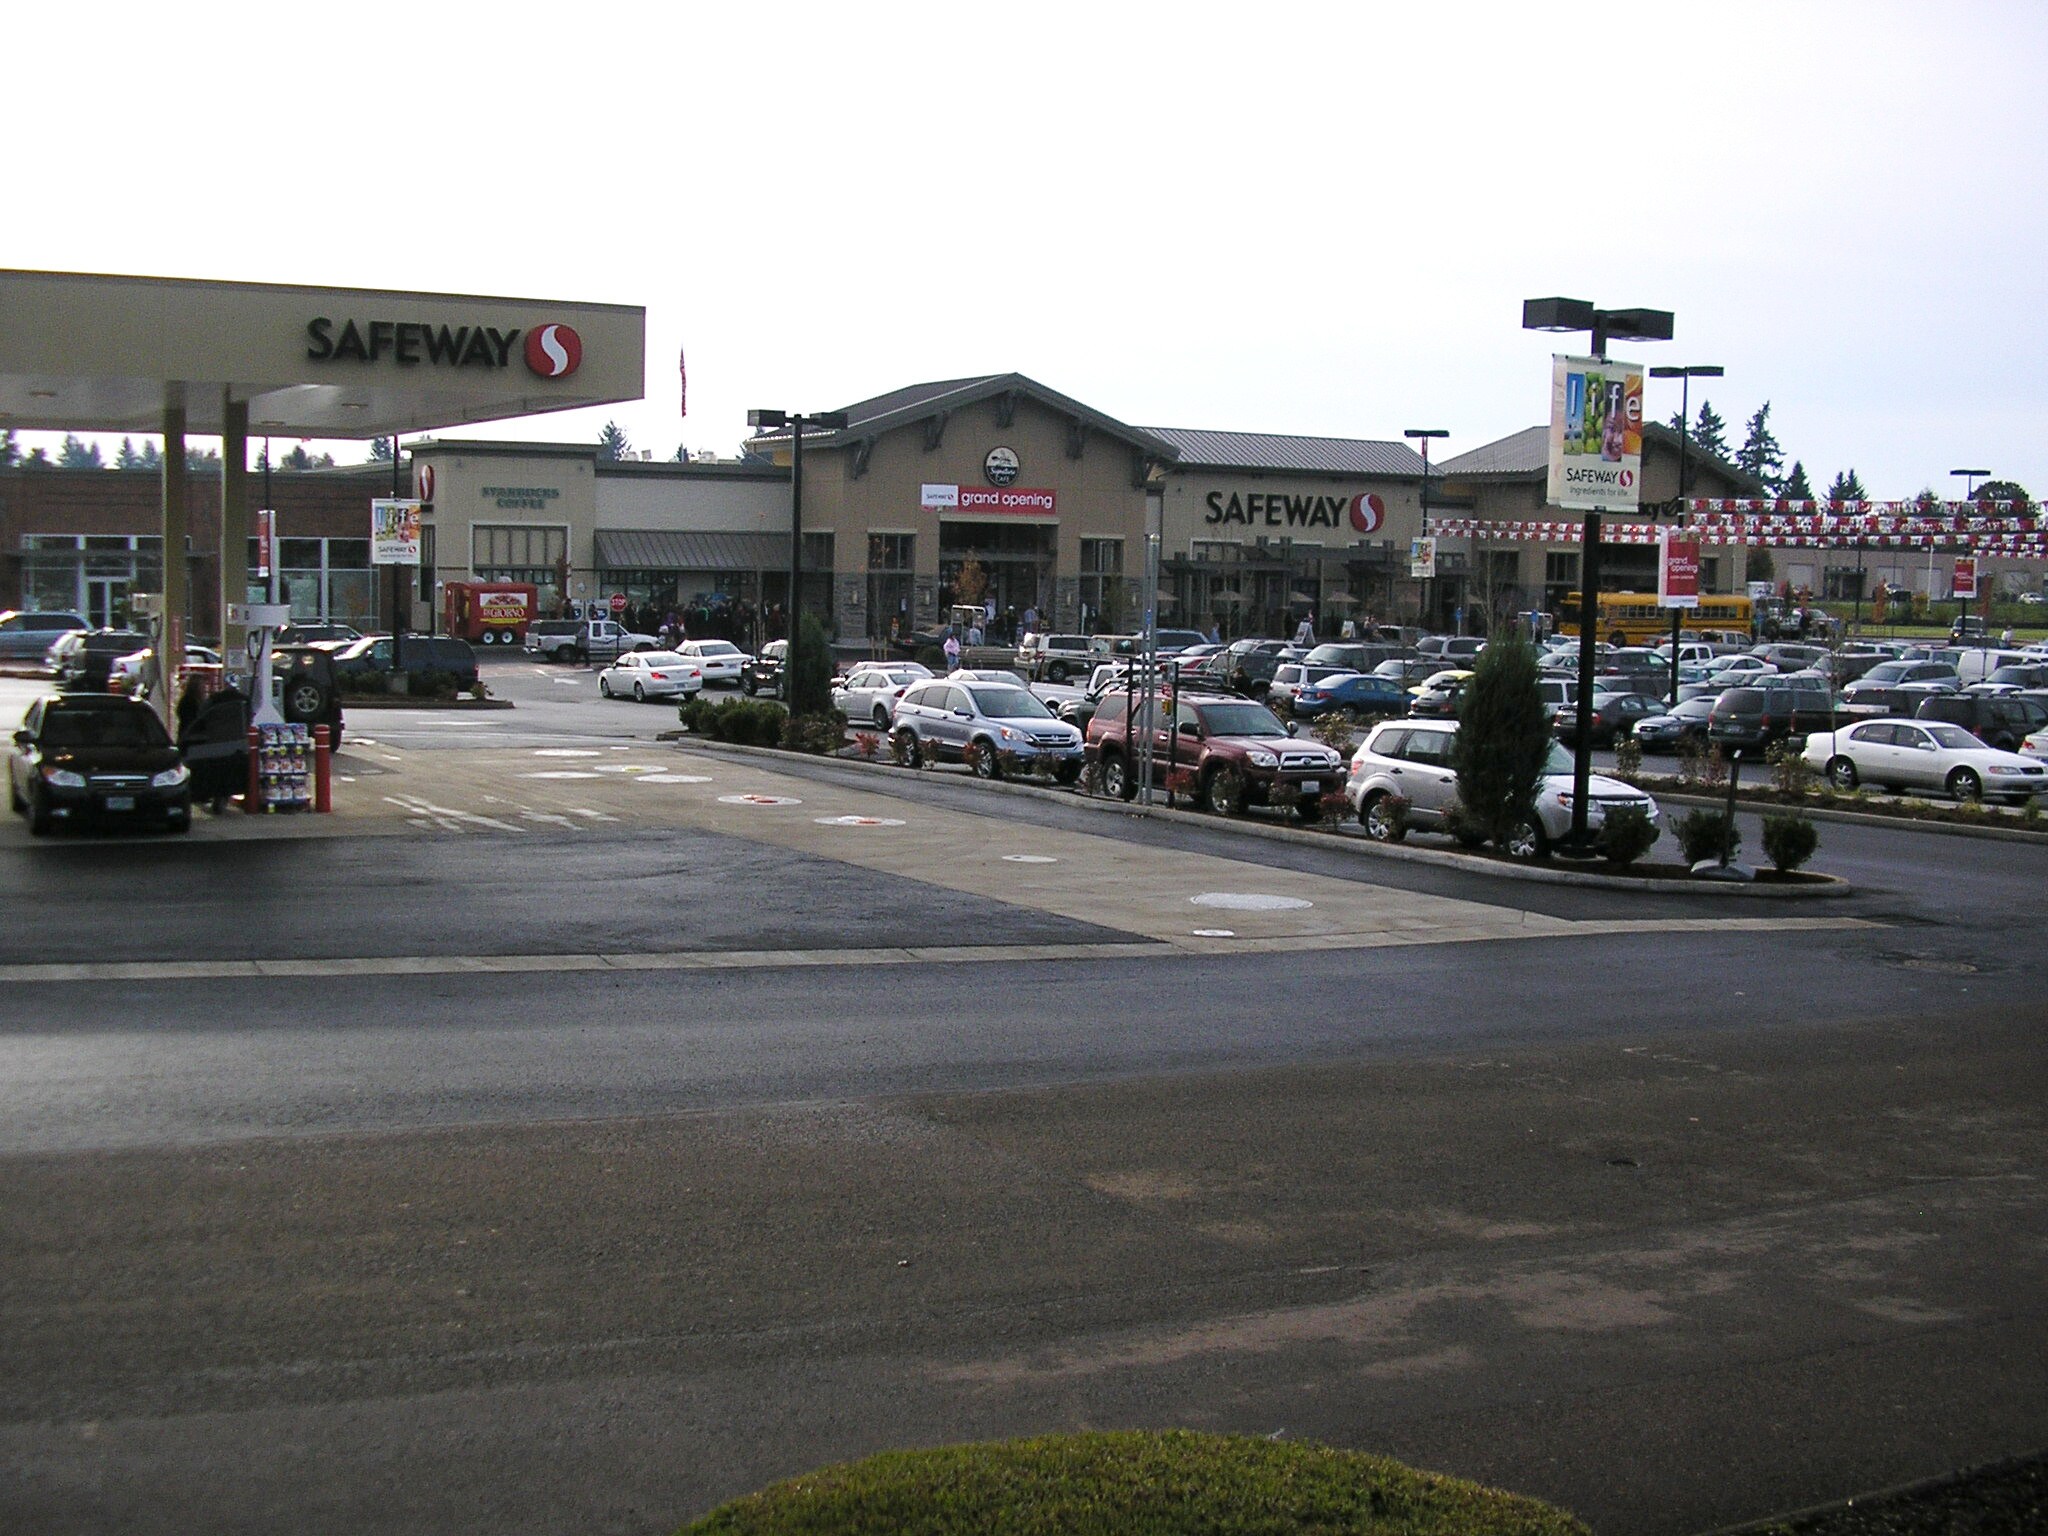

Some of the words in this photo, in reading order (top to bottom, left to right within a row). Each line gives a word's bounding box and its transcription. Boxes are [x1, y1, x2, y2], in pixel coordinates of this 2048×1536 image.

[307, 316, 521, 367] SAFEWAY
[1570, 379, 1641, 421] life
[1566, 467, 1619, 484] SAFEWAY
[482, 487, 560, 498] STARBUCKS
[1568, 486, 1606, 496] ingredients
[497, 499, 544, 509] COFFEE
[961, 492, 999, 506] grand
[1002, 495, 1053, 509] opening
[1205, 491, 1348, 527] SAFEWAY
[1667, 557, 1688, 566] grand
[1671, 565, 1698, 574] opening
[612, 598, 626, 606] STOP
